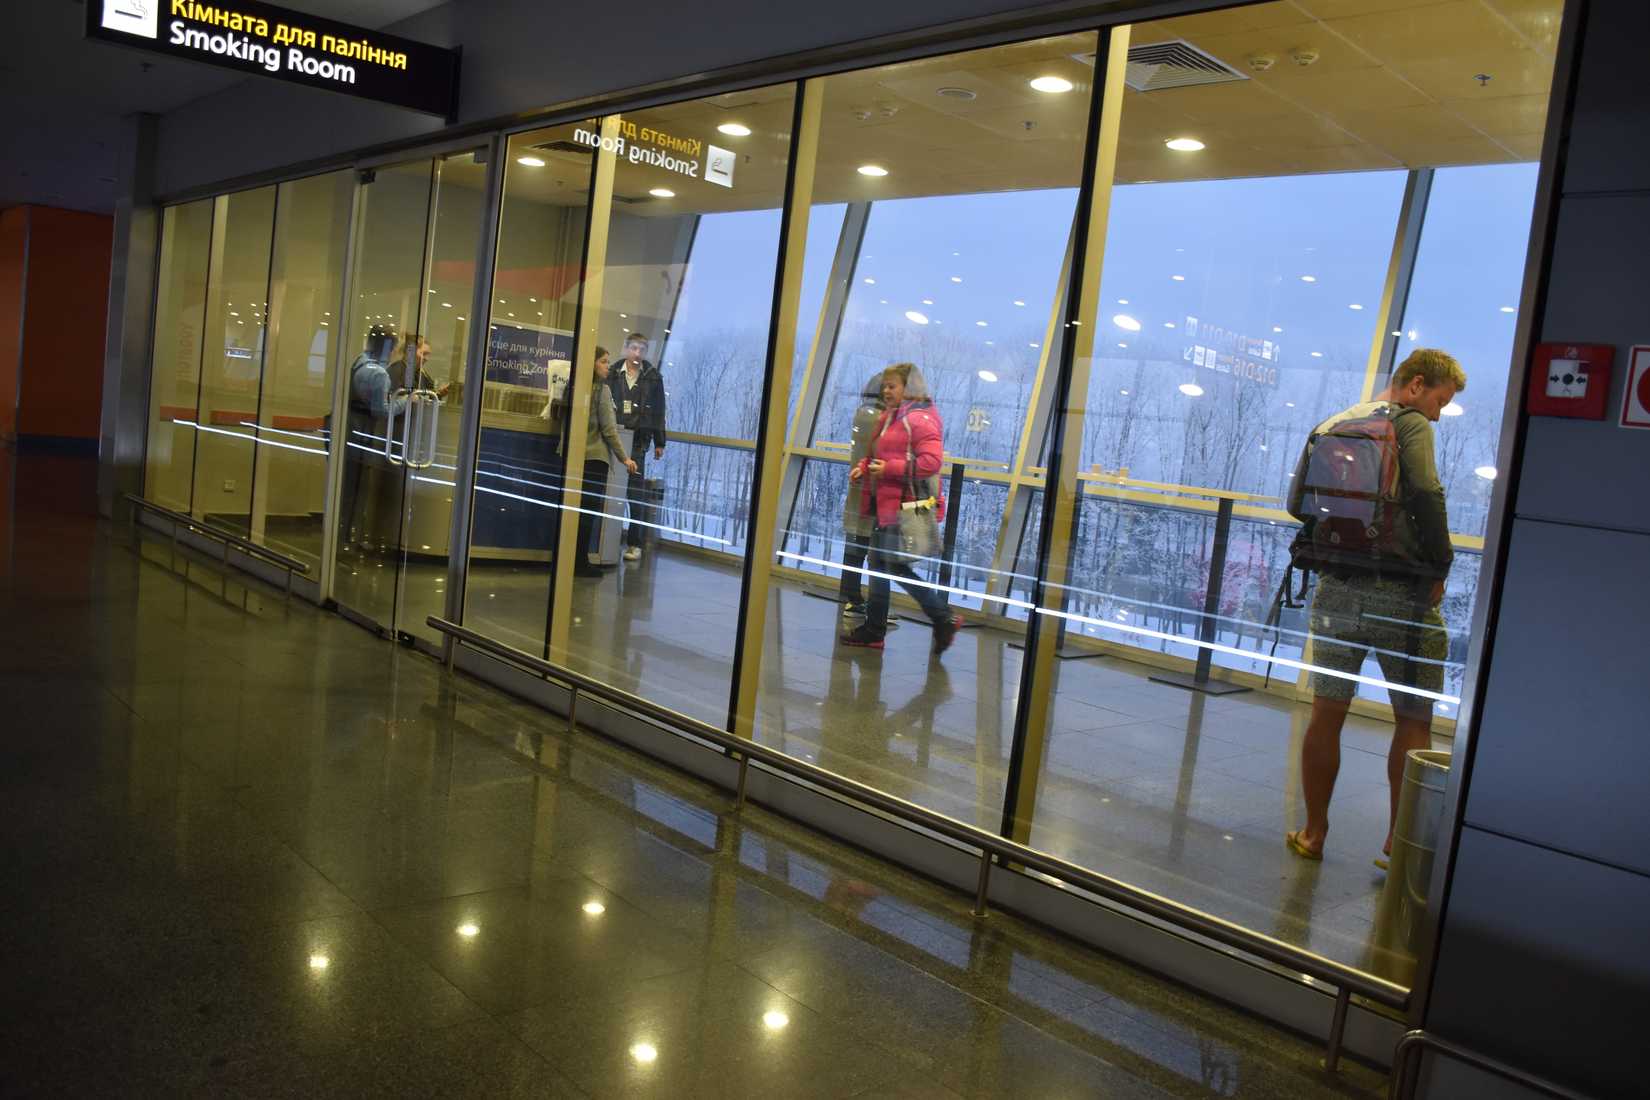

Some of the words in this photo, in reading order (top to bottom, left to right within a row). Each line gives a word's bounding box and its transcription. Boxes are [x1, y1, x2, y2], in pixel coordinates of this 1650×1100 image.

[170, 20, 280, 72] Smoking
[288, 48, 356, 84] Room
[171, 0, 268, 37] Кімната
[273, 24, 316, 48] для
[321, 35, 407, 70] паління
[488, 339, 509, 352] ісце
